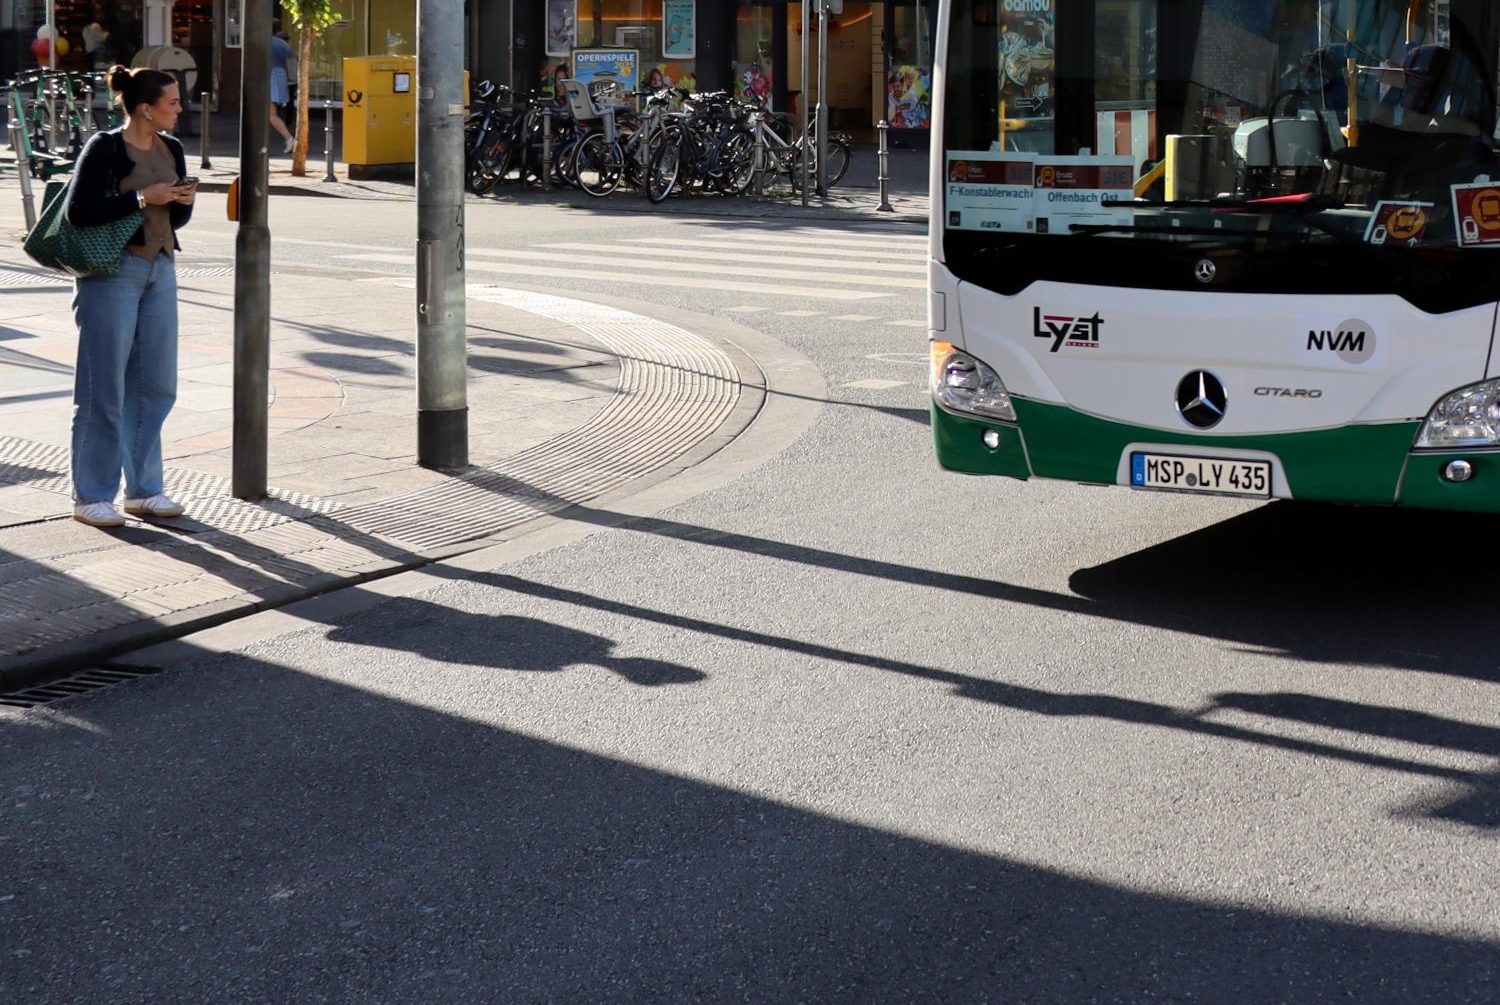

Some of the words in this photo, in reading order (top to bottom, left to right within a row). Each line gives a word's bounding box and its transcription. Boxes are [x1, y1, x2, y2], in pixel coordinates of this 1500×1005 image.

[577, 53, 635, 62] OPERNSPIELE
[1047, 191, 1098, 203] Offenbach
[1101, 192, 1119, 201] Ost
[1033, 306, 1104, 352] Lyst
[1307, 330, 1366, 351] NVM
[1254, 387, 1322, 398] CITARO
[1147, 459, 1184, 484] MSP
[1199, 463, 1223, 487] LY
[1229, 465, 1265, 491] 435
